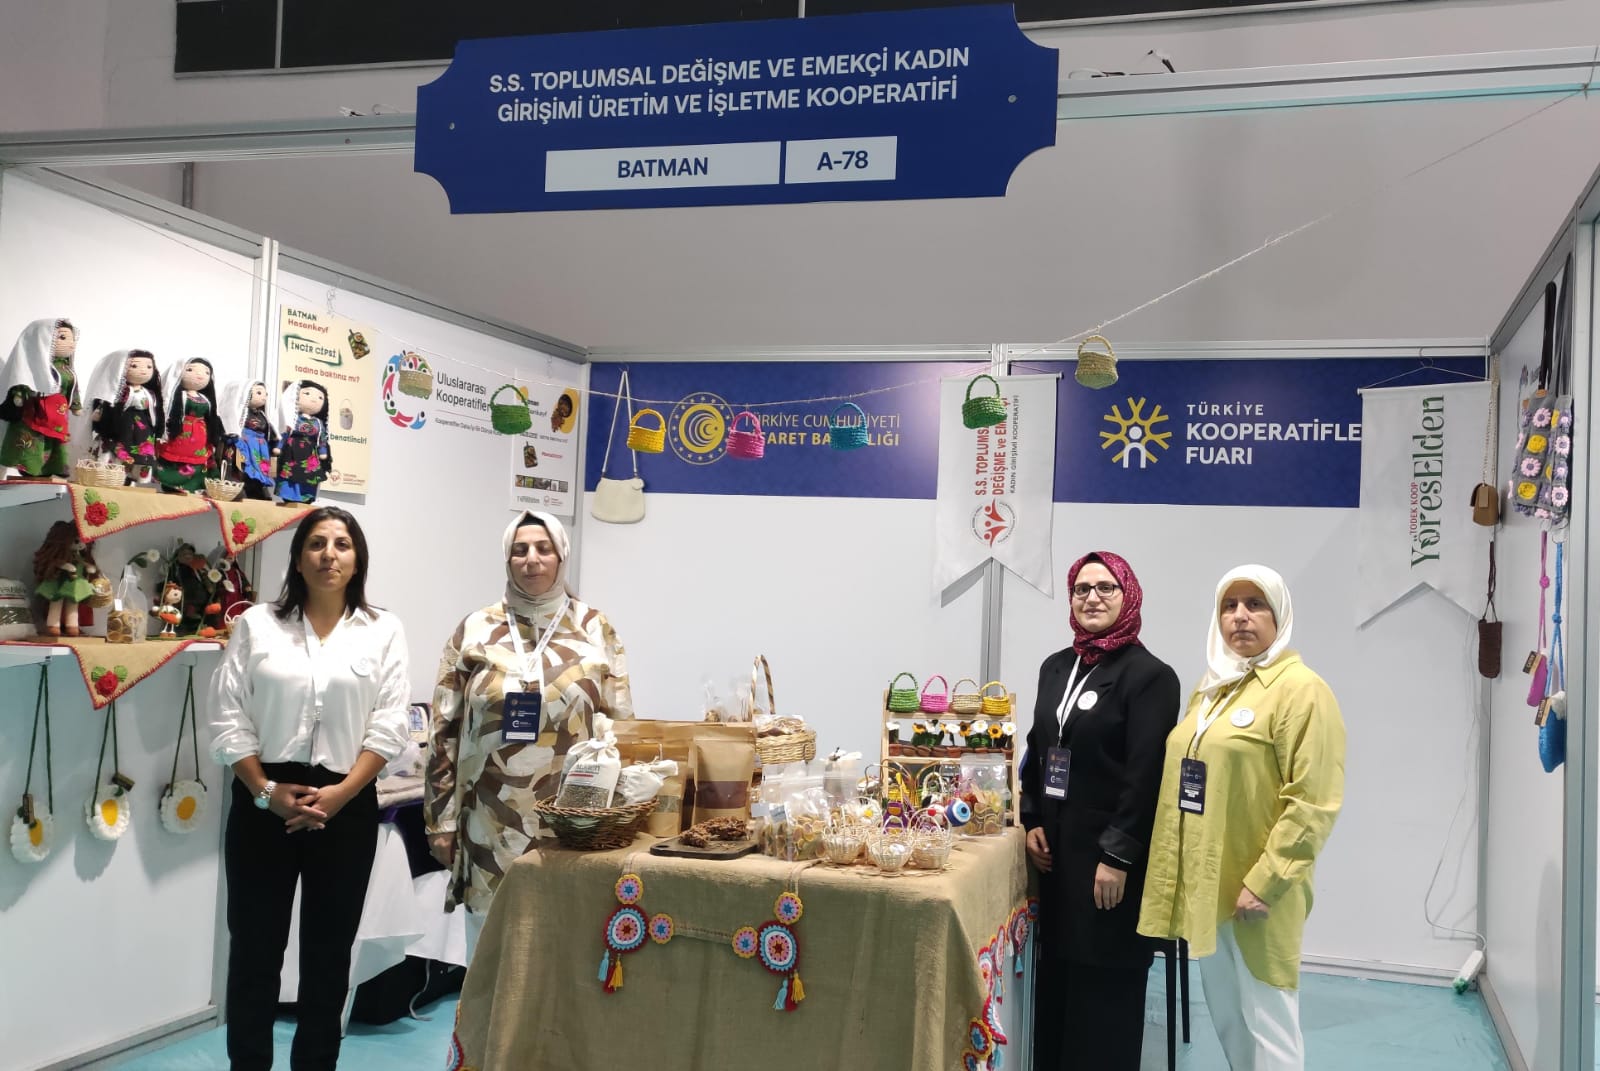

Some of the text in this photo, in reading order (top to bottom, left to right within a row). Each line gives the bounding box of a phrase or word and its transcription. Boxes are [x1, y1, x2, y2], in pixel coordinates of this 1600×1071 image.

[489, 46, 969, 93] S.S. TOPLUMSAL DEĞİŞME VE EMEKÇİ KADIN
[497, 74, 958, 125] GİRİŞİMİ ÜRETİM VE İŞLETME KOOPERATİFİ
[617, 156, 709, 179] BATMAN
[816, 150, 869, 171] A-78
[287, 308, 317, 321] BATMAN
[288, 318, 329, 334] Hasankeyf
[291, 340, 337, 358] İNCİR CİPSİ
[437, 371, 487, 396] Uluslararası
[436, 388, 490, 412] Kooperatifler
[1186, 401, 1264, 416] TÜRKİYE
[755, 430, 900, 447] ARET BALIĞI
[1186, 418, 1362, 441] KOOPERATİFLE
[997, 438, 1006, 449] ve
[974, 426, 990, 496] S.S. TOPLUMS
[1185, 446, 1253, 465] FUARI
[990, 452, 1009, 496] DEĞİŞME
[1009, 472, 1017, 494] KADIN
[1410, 481, 1420, 505] KOOP
